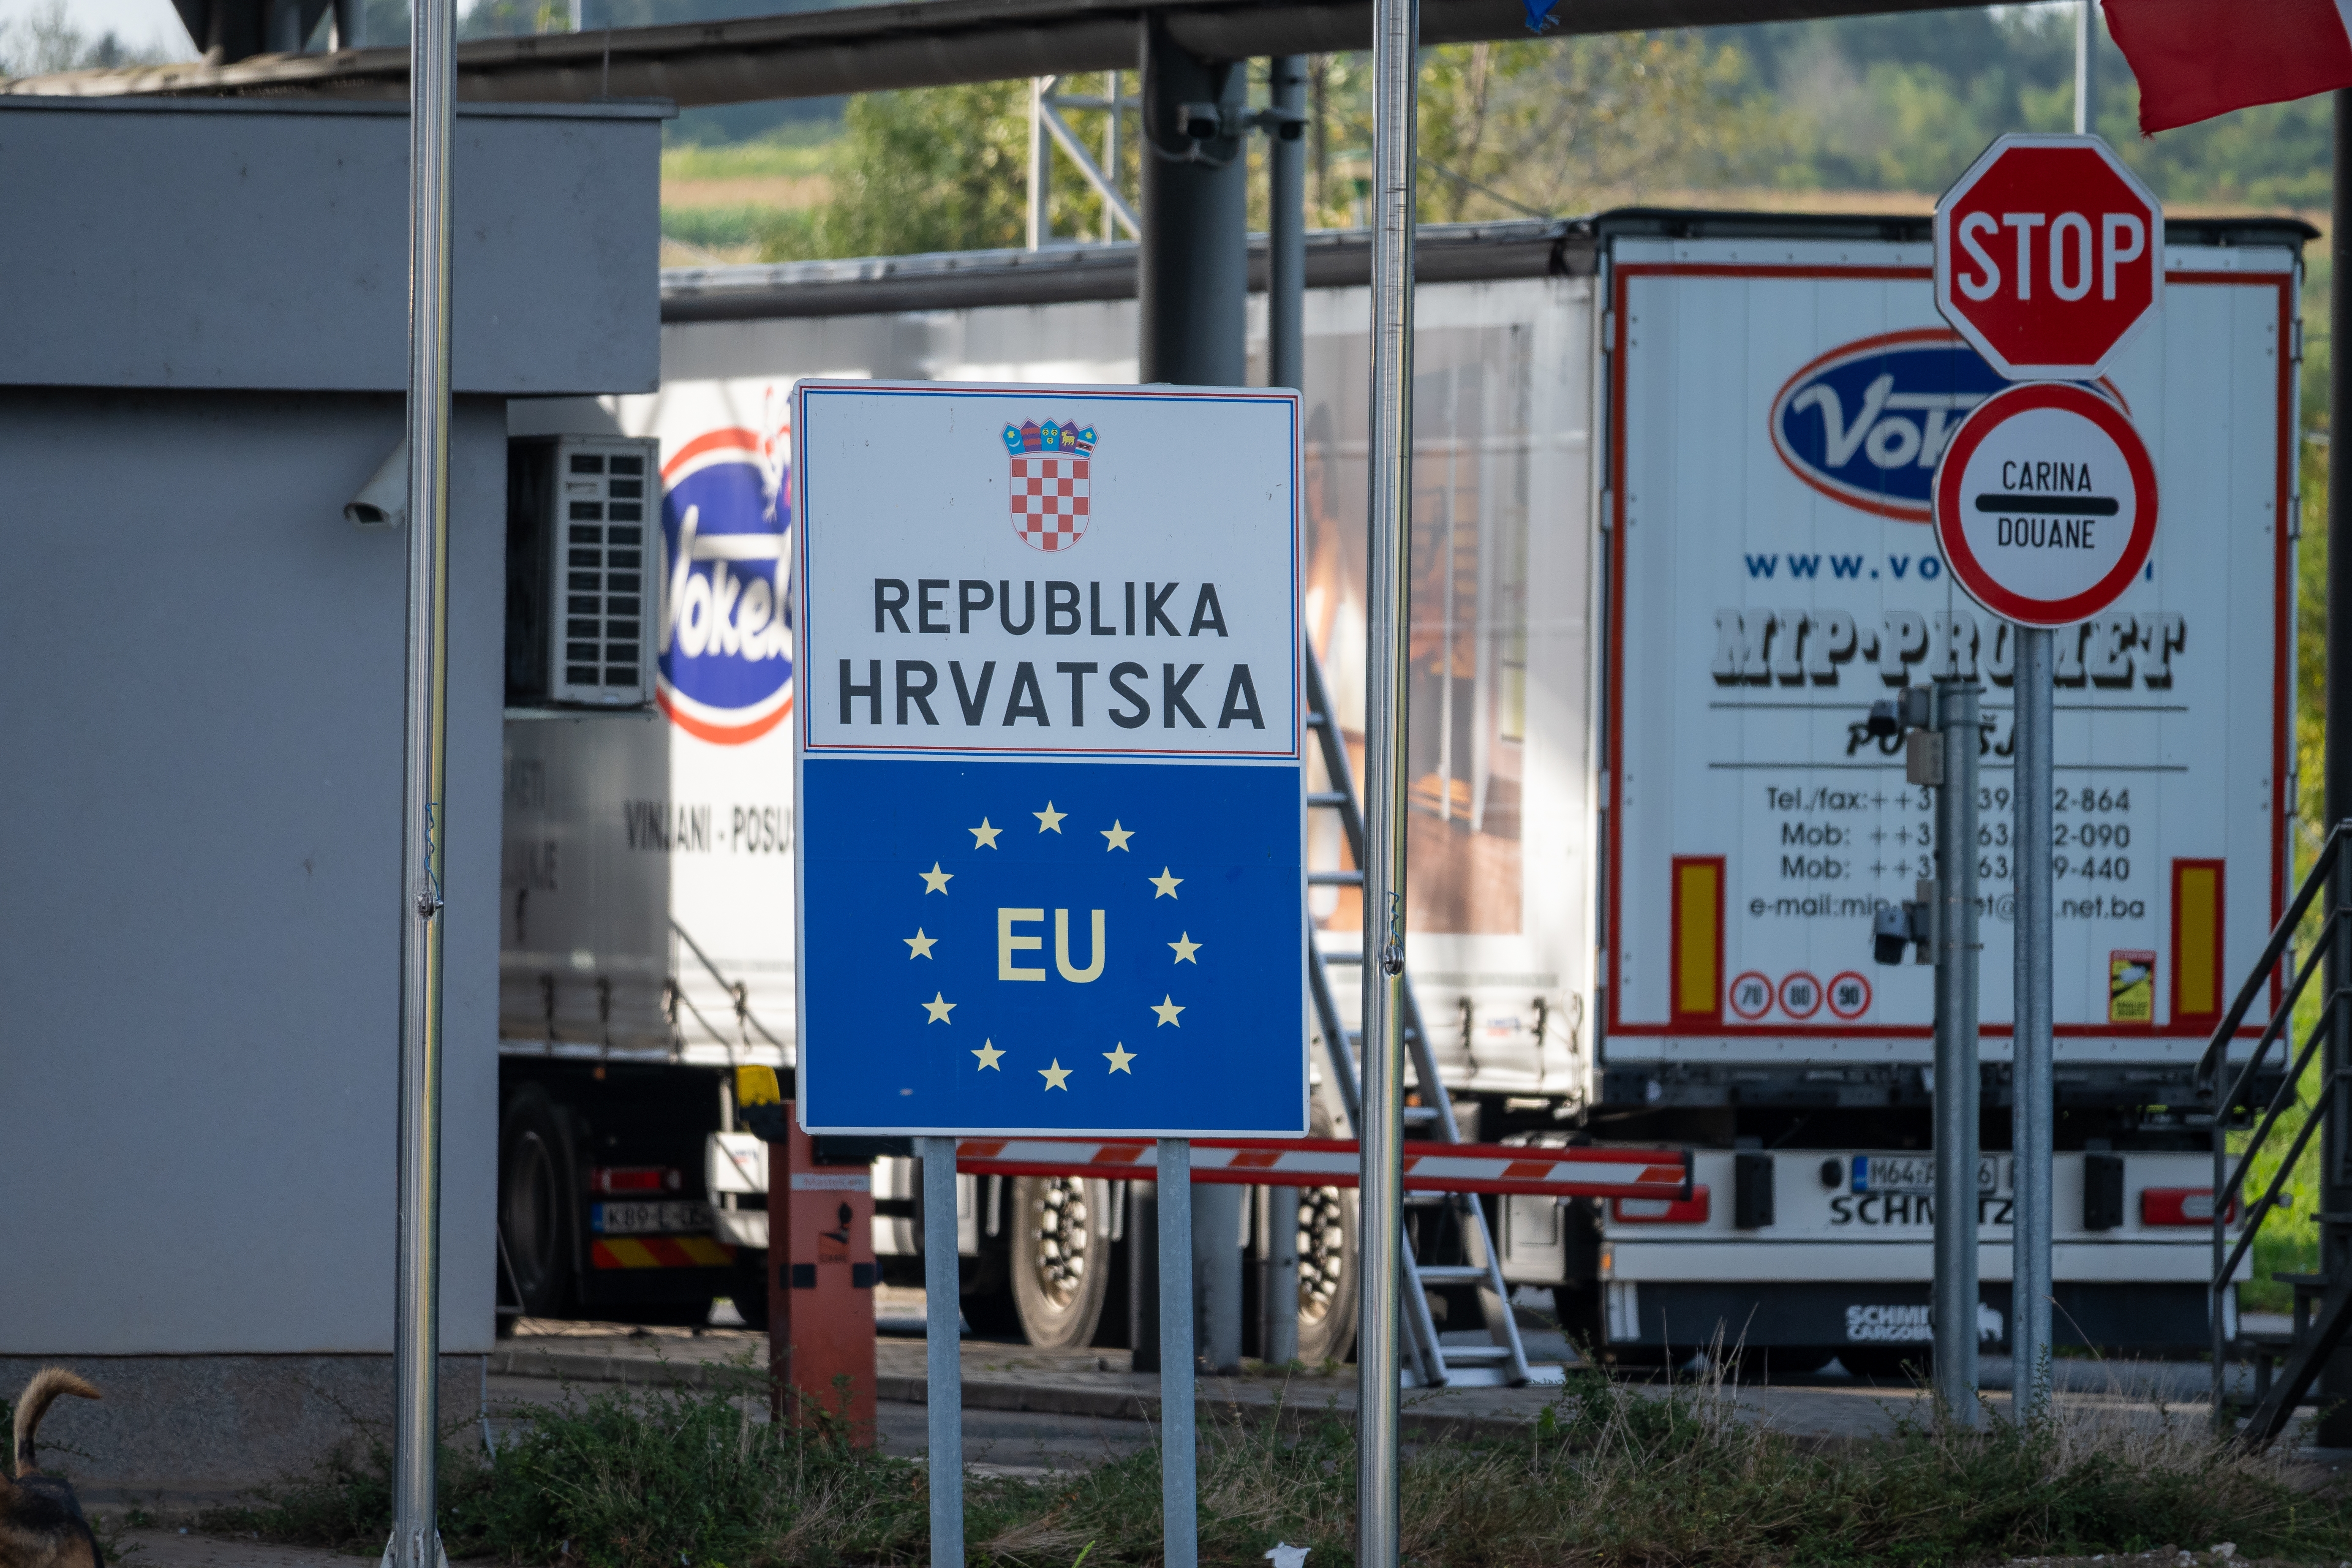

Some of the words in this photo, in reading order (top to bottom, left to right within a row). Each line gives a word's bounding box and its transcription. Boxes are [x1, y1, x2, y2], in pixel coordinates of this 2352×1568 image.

[1957, 211, 2145, 302] STOP
[1792, 373, 1981, 470] Vok
[2003, 460, 2092, 492] CARINA
[1998, 517, 2096, 549] DOUANE
[874, 577, 1229, 637] REPUBLIKA
[839, 659, 1266, 730] HRVATSKA
[733, 804, 793, 854] POSU
[1781, 821, 1851, 847] Mob:
[1780, 854, 1851, 879] Mob:
[998, 907, 1105, 983] EU
[1831, 1195, 2014, 1224] SCHMTZ
[1846, 1304, 1929, 1325] SCHMI
